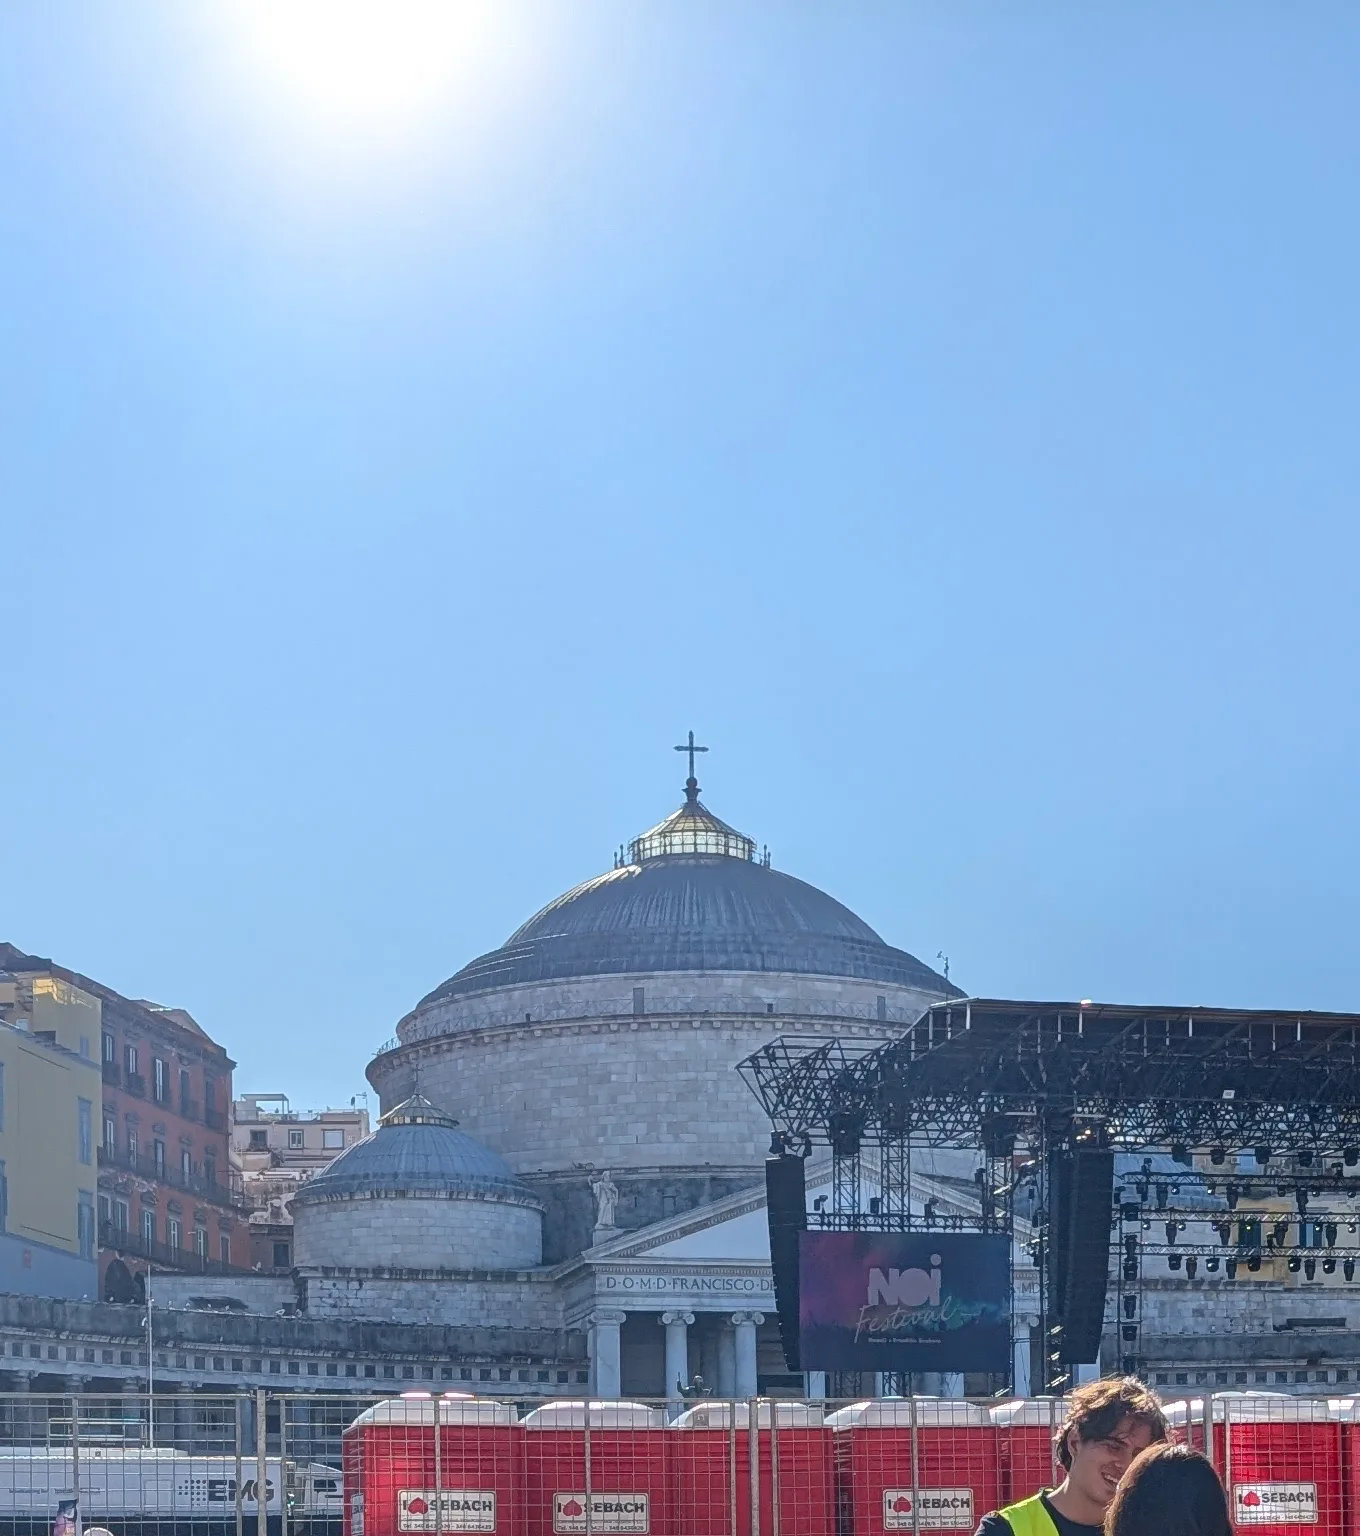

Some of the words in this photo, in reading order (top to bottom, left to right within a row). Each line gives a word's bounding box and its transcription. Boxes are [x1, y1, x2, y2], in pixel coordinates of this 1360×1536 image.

[853, 1295, 958, 1343] Festival
[208, 1479, 274, 1502] EMG
[1261, 1492, 1315, 1503] SEBACH
[430, 1500, 492, 1511] SEBACH
[584, 1502, 645, 1513] SEBACH
